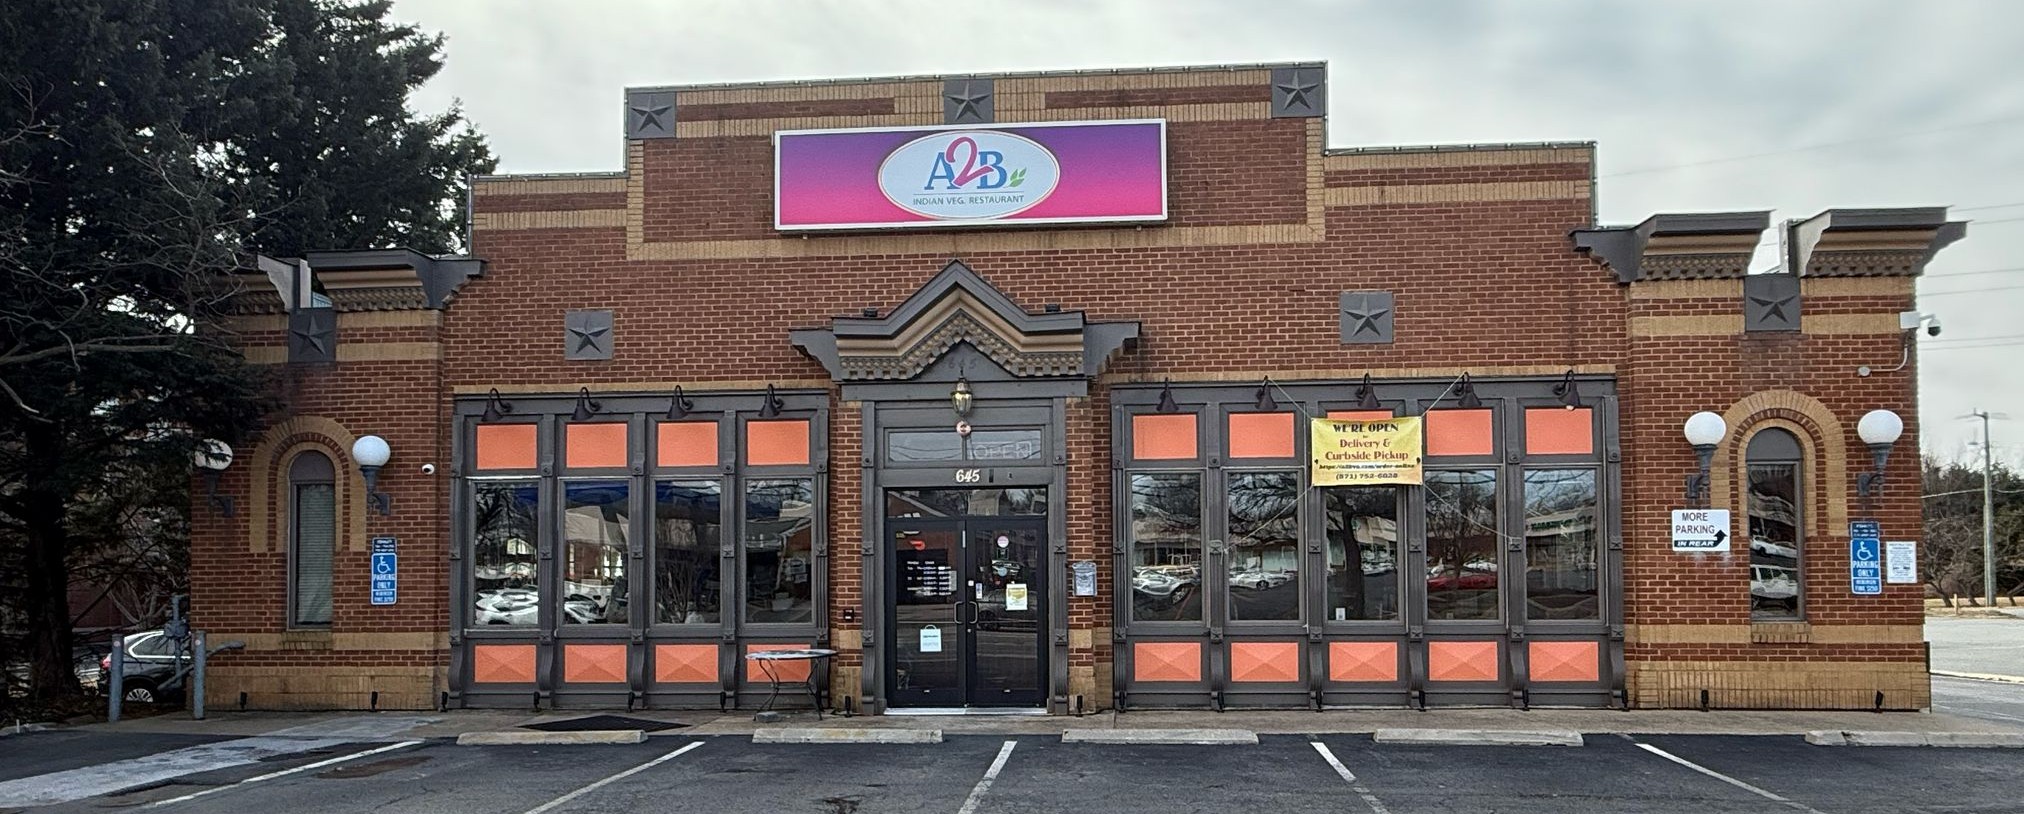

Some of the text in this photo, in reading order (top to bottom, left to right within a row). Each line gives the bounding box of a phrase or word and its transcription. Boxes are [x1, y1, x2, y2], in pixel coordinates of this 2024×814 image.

[924, 136, 1008, 190] A2B
[913, 194, 1025, 206] INDIAN VEG. RESTAURANT
[1333, 423, 1399, 432] WE'RE OPEN
[1340, 438, 1391, 448] Delivery &
[1325, 450, 1409, 461] Curbside Pickup
[955, 468, 981, 483] 645
[1681, 512, 1709, 521] MORE
[1675, 524, 1715, 534] PARKING
[1852, 560, 1879, 568] PARKING
[1857, 569, 1874, 577] ONLY
